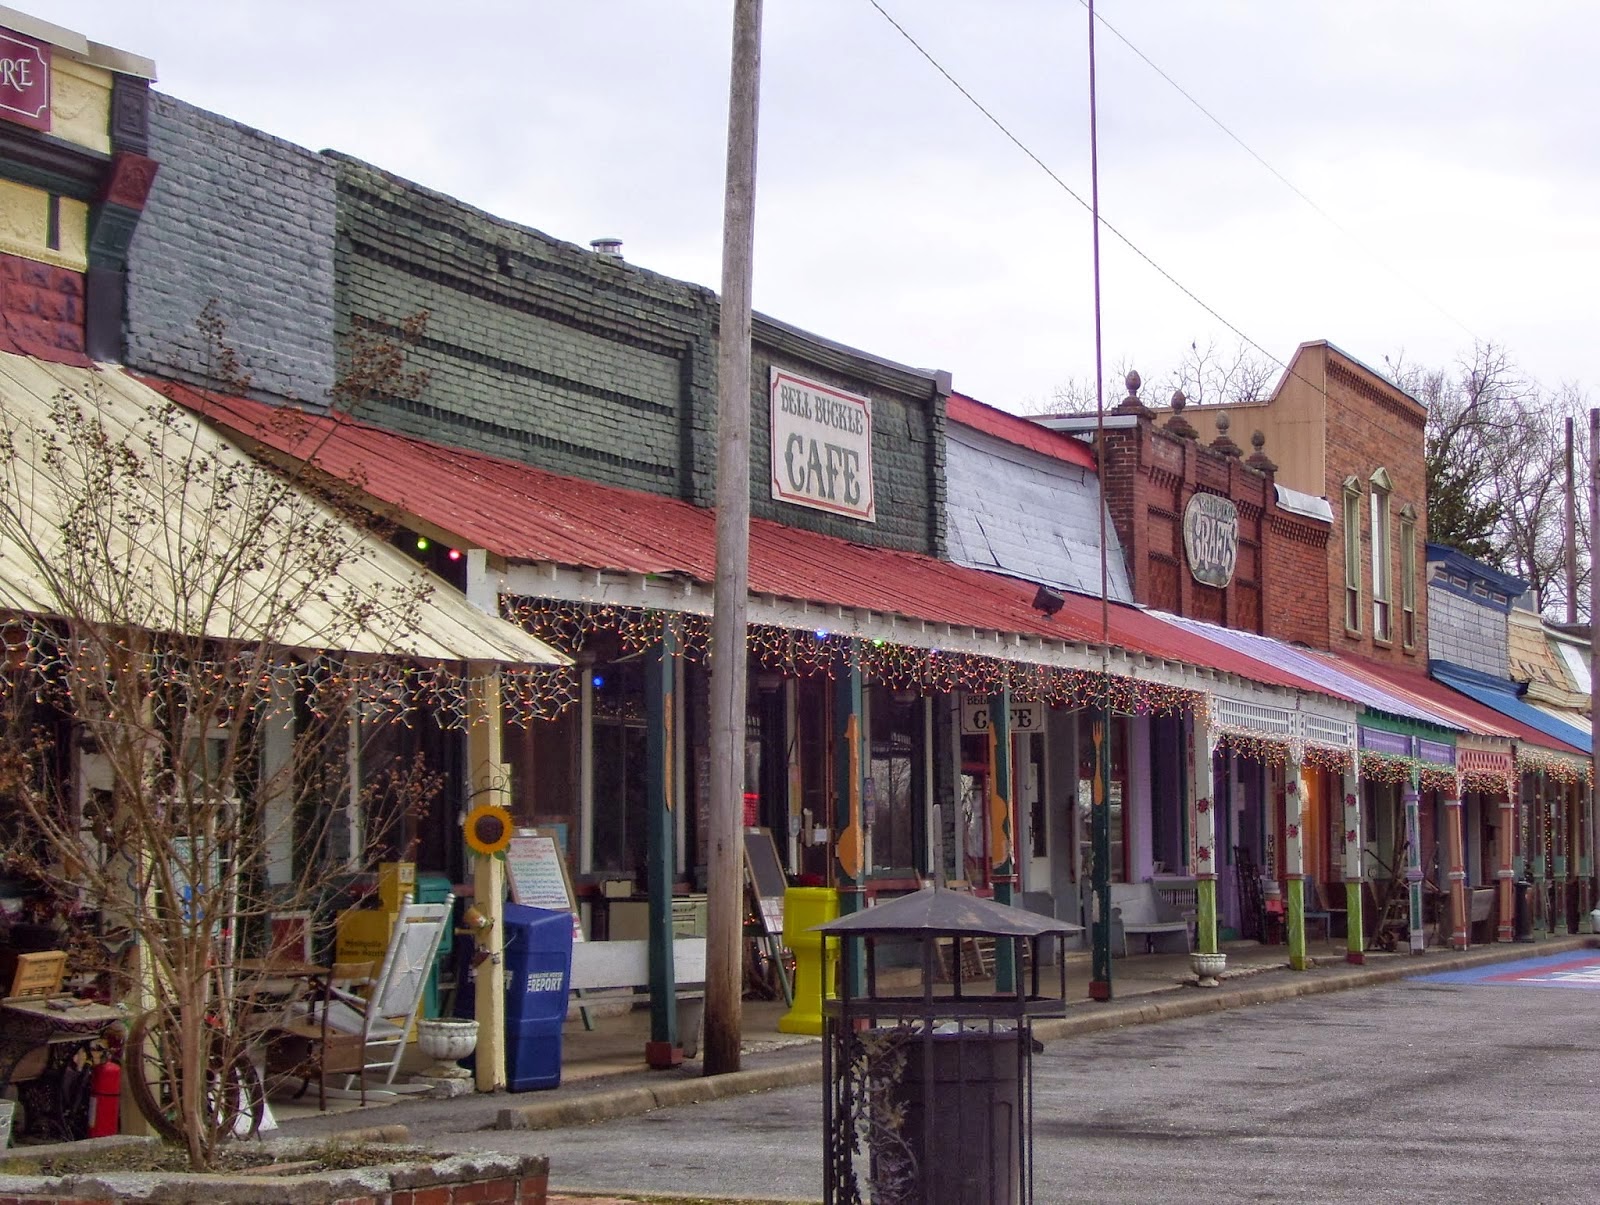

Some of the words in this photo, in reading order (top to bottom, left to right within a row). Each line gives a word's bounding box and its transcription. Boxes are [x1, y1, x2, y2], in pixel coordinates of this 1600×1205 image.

[780, 384, 813, 419] BELL
[814, 395, 864, 436] BUCKLE
[785, 433, 860, 505] CAFE
[1185, 500, 1238, 580] CRAFTS
[967, 695, 989, 705] BEL
[973, 709, 1032, 729] CFE
[531, 978, 562, 992] REPORT
